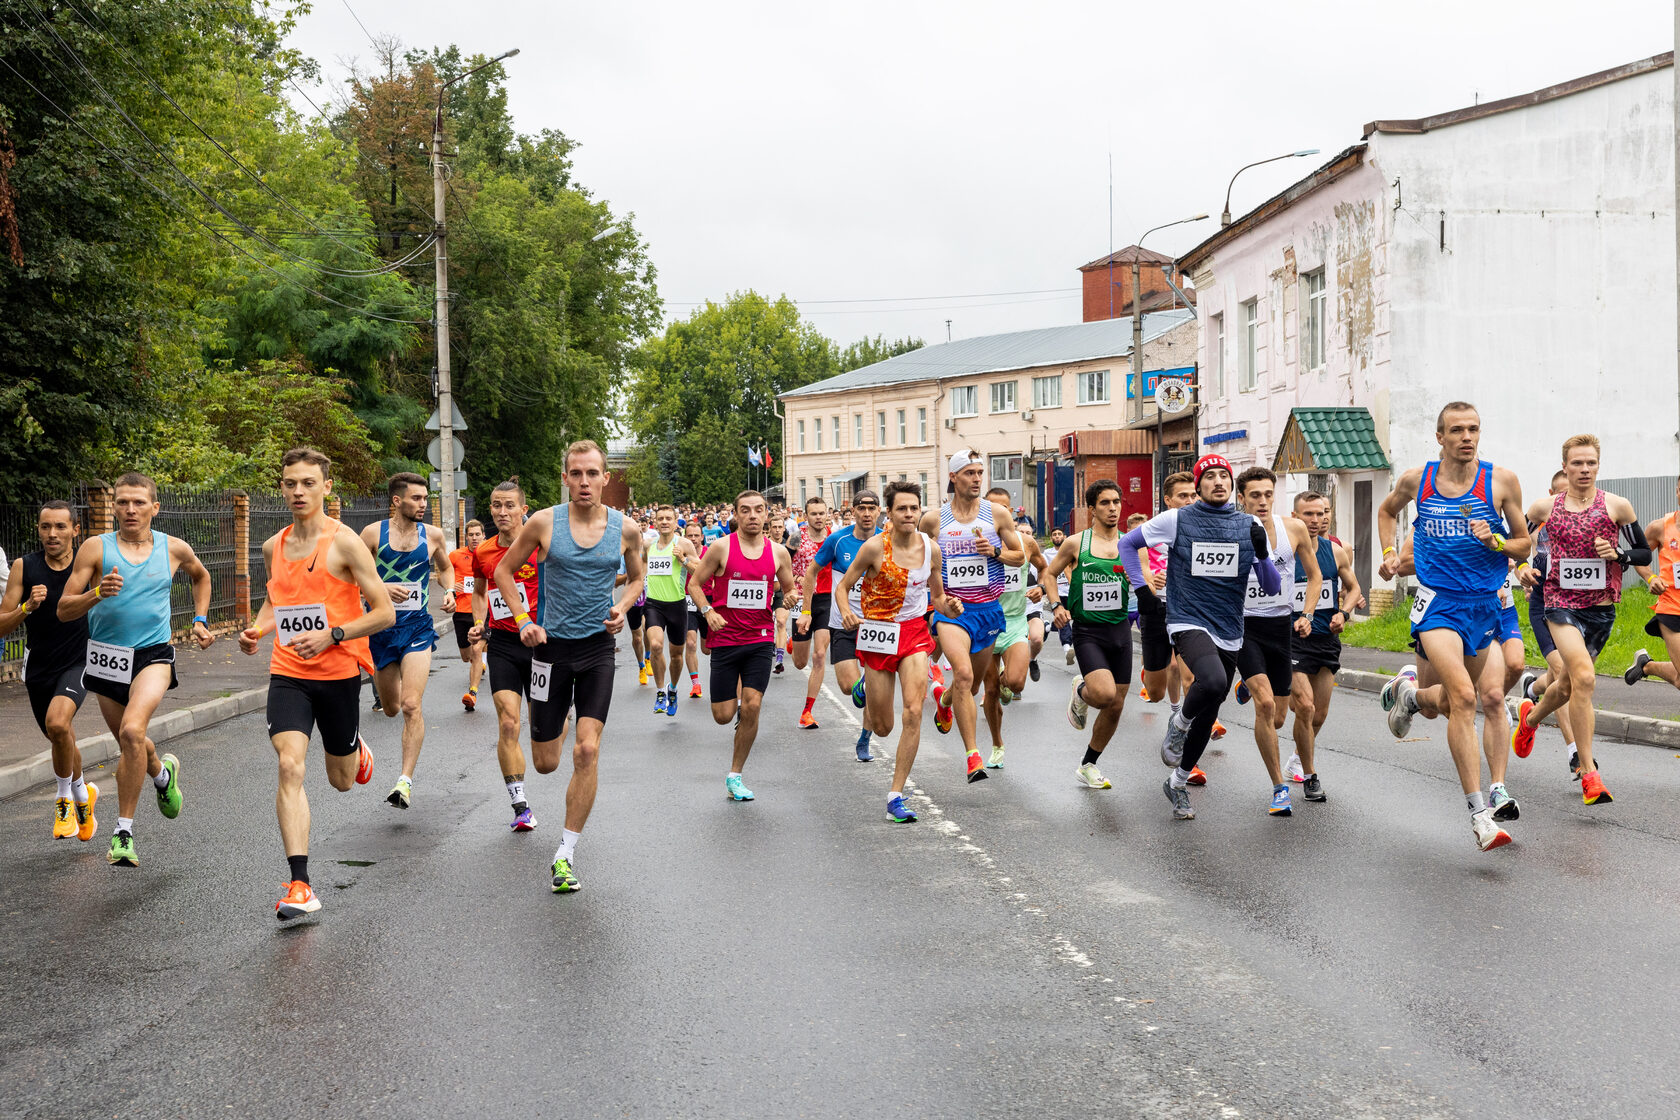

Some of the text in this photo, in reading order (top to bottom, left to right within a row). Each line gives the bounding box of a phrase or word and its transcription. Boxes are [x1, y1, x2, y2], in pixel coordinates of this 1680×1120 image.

[1200, 458, 1227, 470] RUS
[1196, 552, 1235, 565] 4597
[649, 561, 671, 569] 3849
[950, 565, 984, 577] 4998
[1082, 572, 1122, 583] MOROCCO
[1564, 567, 1600, 579] 3891
[731, 589, 764, 600] 4418
[1087, 590, 1118, 602] 3914
[281, 616, 325, 632] 4606
[861, 628, 896, 644] 3904
[90, 651, 129, 672] 3863
